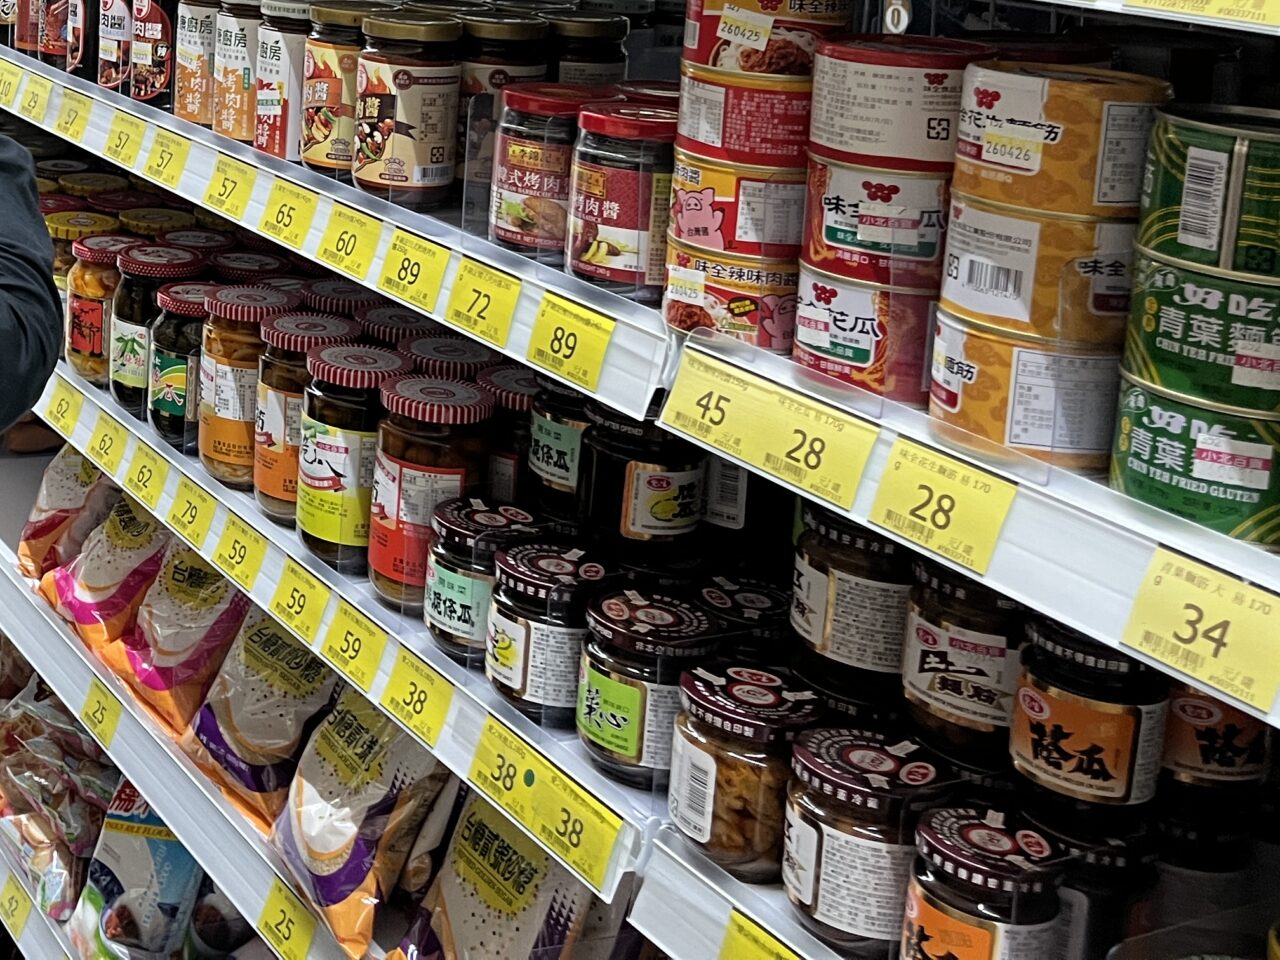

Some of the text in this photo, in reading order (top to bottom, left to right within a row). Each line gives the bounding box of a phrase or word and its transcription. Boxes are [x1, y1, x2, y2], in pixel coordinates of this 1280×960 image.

[720, 20, 761, 42] 260425
[27, 91, 39, 109] 29
[115, 130, 130, 150] 57
[985, 141, 1031, 161] 260426
[158, 150, 173, 170] 57
[218, 177, 237, 199] 57
[275, 203, 295, 228] 65
[335, 230, 358, 256] 60
[396, 257, 420, 286] 89
[1079, 260, 1125, 276] 味全
[467, 288, 491, 320] 72
[550, 326, 577, 360] 89
[56, 399, 70, 417] 62
[696, 390, 731, 426] 45
[99, 433, 114, 456] 62
[785, 429, 826, 470] 28
[1201, 452, 1264, 470] 小北百貨
[138, 467, 153, 490] 62
[972, 479, 992, 493] 170
[1171, 475, 1209, 494] FRIED
[184, 500, 198, 525] 79
[909, 484, 956, 530] 28
[228, 544, 247, 566] 59
[286, 590, 306, 615] 59
[1248, 597, 1272, 616] 170
[1172, 603, 1232, 659] 34
[340, 630, 362, 660] 59
[403, 681, 428, 715] 38
[93, 701, 106, 723] 25
[491, 753, 518, 792] 38
[556, 808, 585, 849] 38
[278, 910, 296, 941] 25
